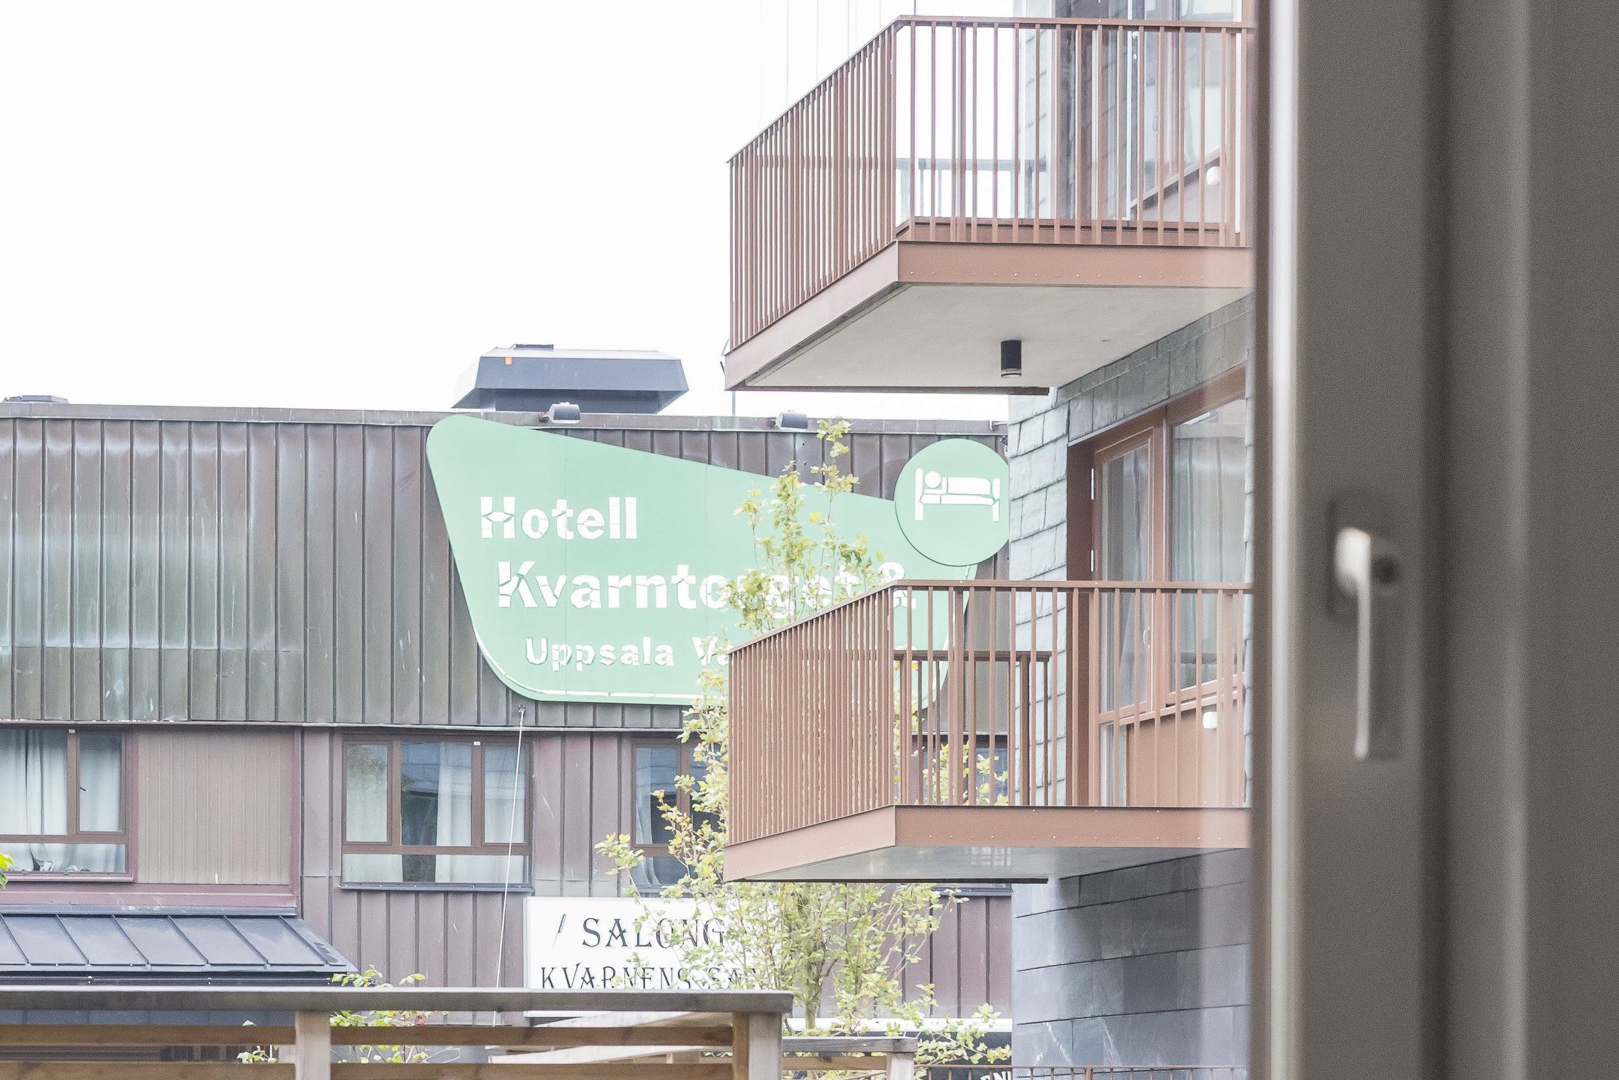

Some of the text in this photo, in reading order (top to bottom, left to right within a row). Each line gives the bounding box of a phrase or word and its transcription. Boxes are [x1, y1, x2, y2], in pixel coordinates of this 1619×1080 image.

[480, 496, 638, 540] Hotell
[525, 636, 675, 672] Uppsala
[581, 917, 726, 949] SALONG
